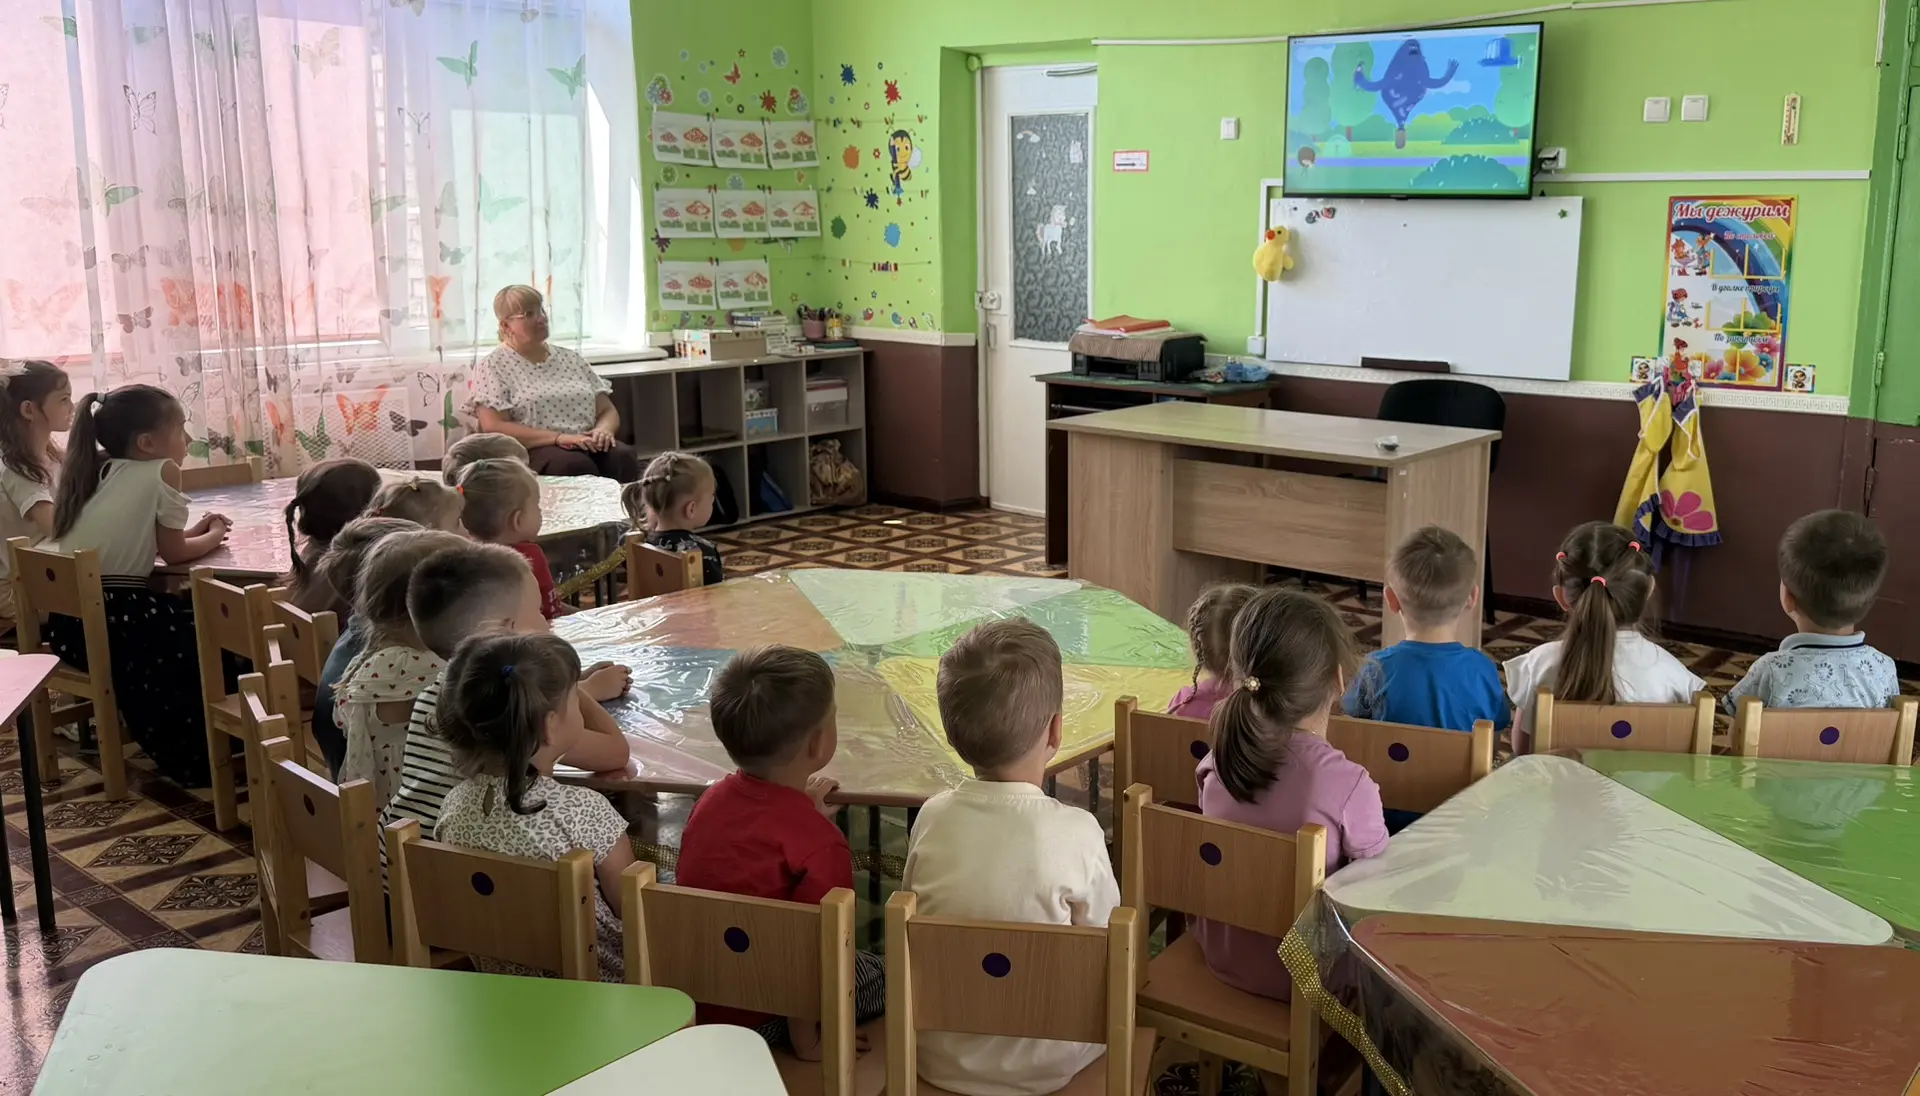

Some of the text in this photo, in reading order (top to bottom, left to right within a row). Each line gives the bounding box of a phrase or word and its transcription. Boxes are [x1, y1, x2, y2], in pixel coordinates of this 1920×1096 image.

[1675, 203, 1789, 222] Мы дежурим
[1711, 283, 1717, 291] В
